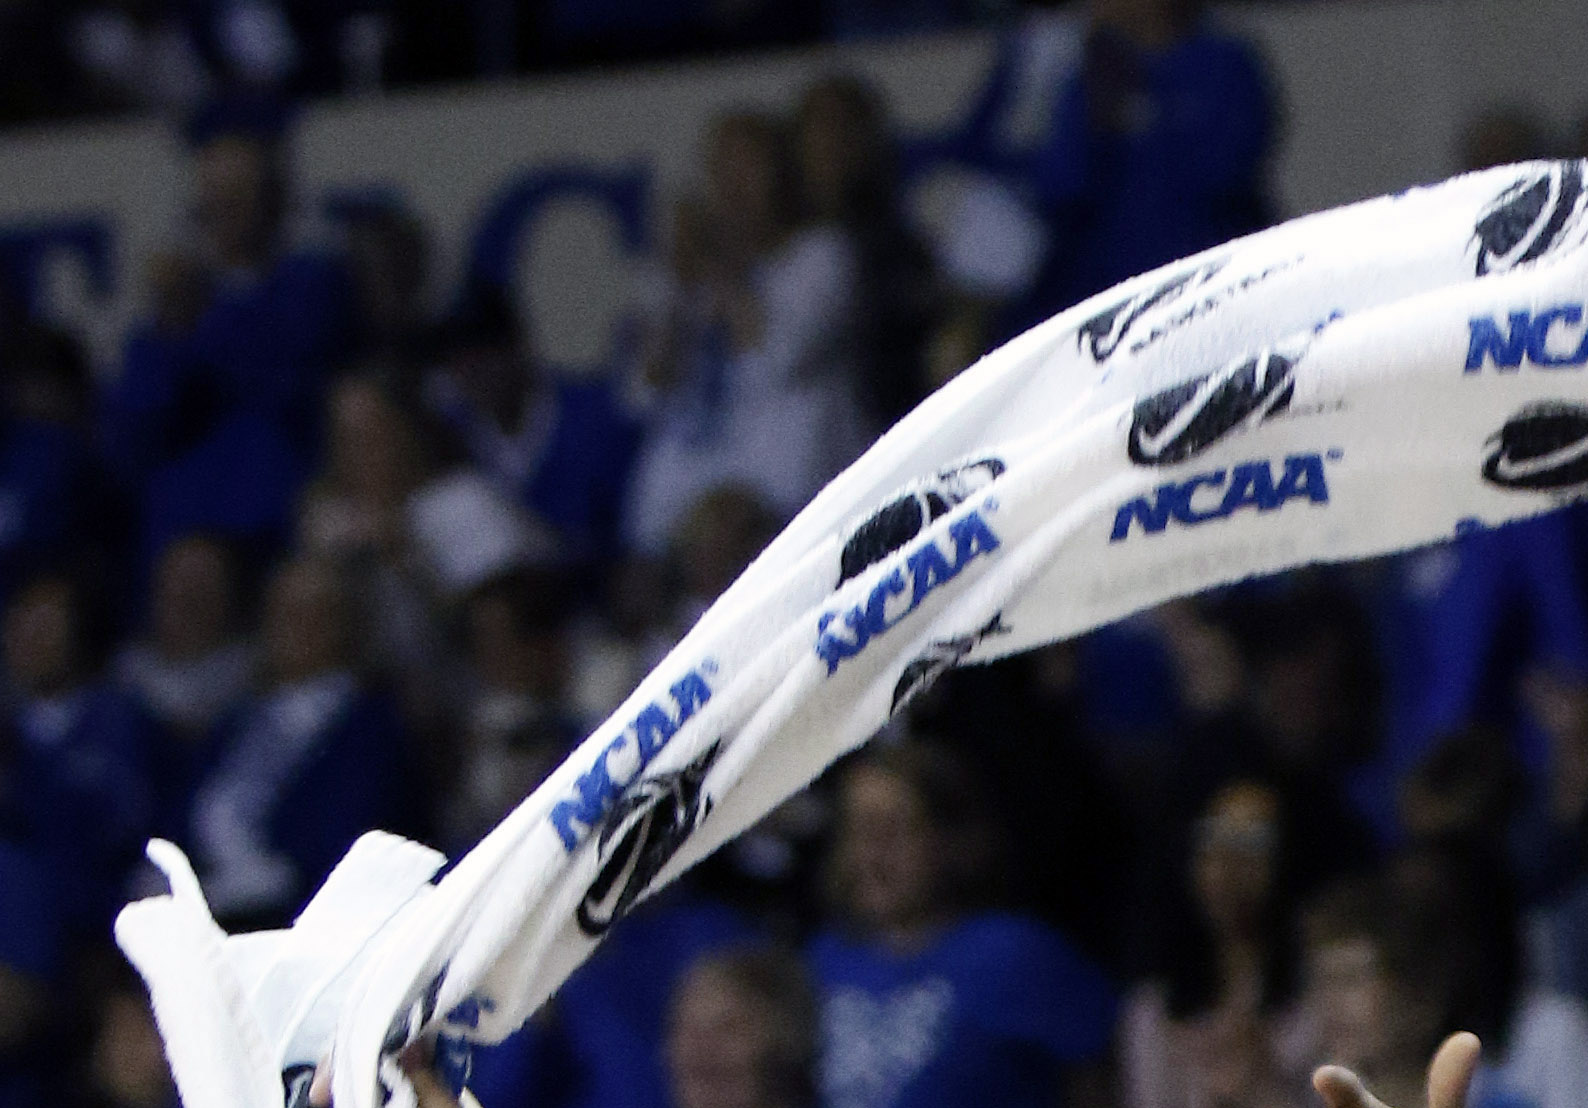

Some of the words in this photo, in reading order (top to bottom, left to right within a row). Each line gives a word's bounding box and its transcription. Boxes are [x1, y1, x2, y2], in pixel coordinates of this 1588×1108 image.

[1110, 454, 1331, 542] NCAA
[814, 510, 1003, 674] NCAA
[549, 670, 714, 852] NCAA
